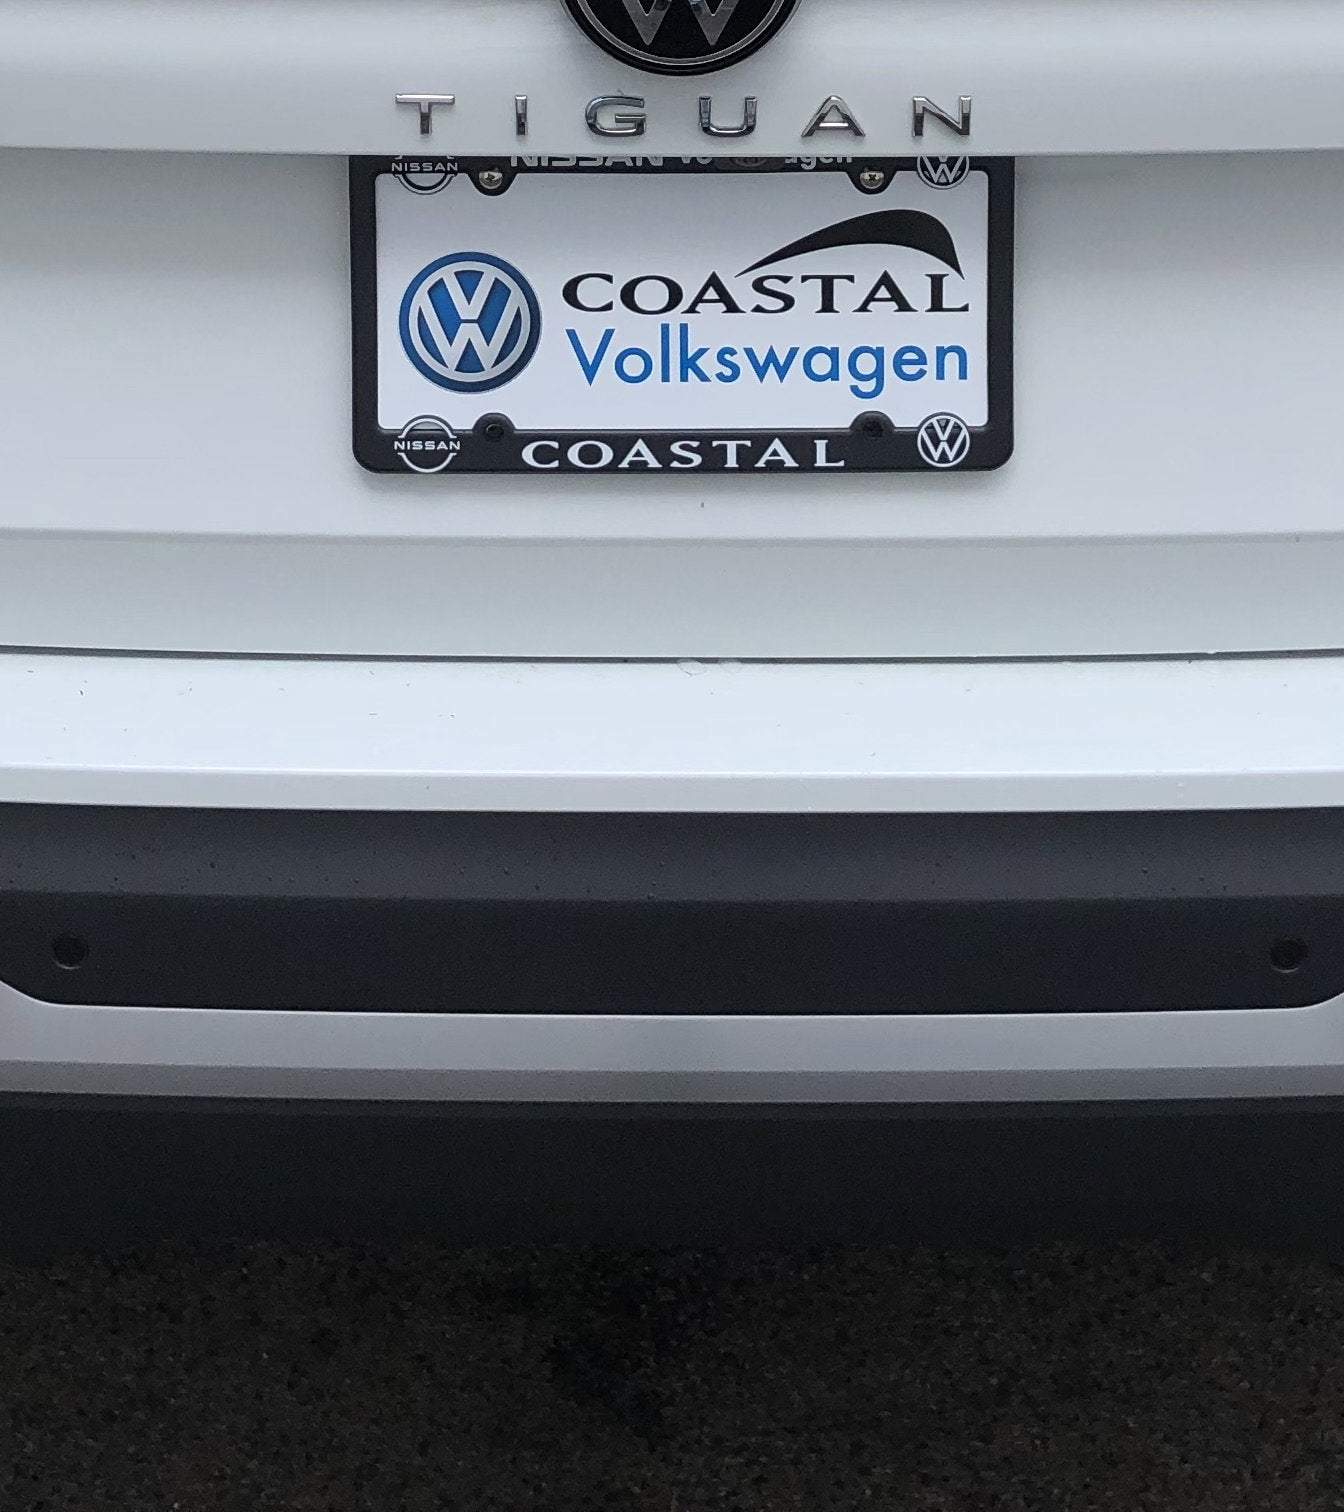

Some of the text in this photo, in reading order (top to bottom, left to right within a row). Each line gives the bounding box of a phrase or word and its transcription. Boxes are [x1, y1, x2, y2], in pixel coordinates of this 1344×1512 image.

[395, 93, 972, 139] TIGUAN
[391, 162, 458, 172] NISSAN
[561, 272, 970, 316] COASTAL
[565, 323, 969, 400] Volkswagen
[393, 440, 461, 451] NISSAN
[521, 438, 845, 469] COASTAL
